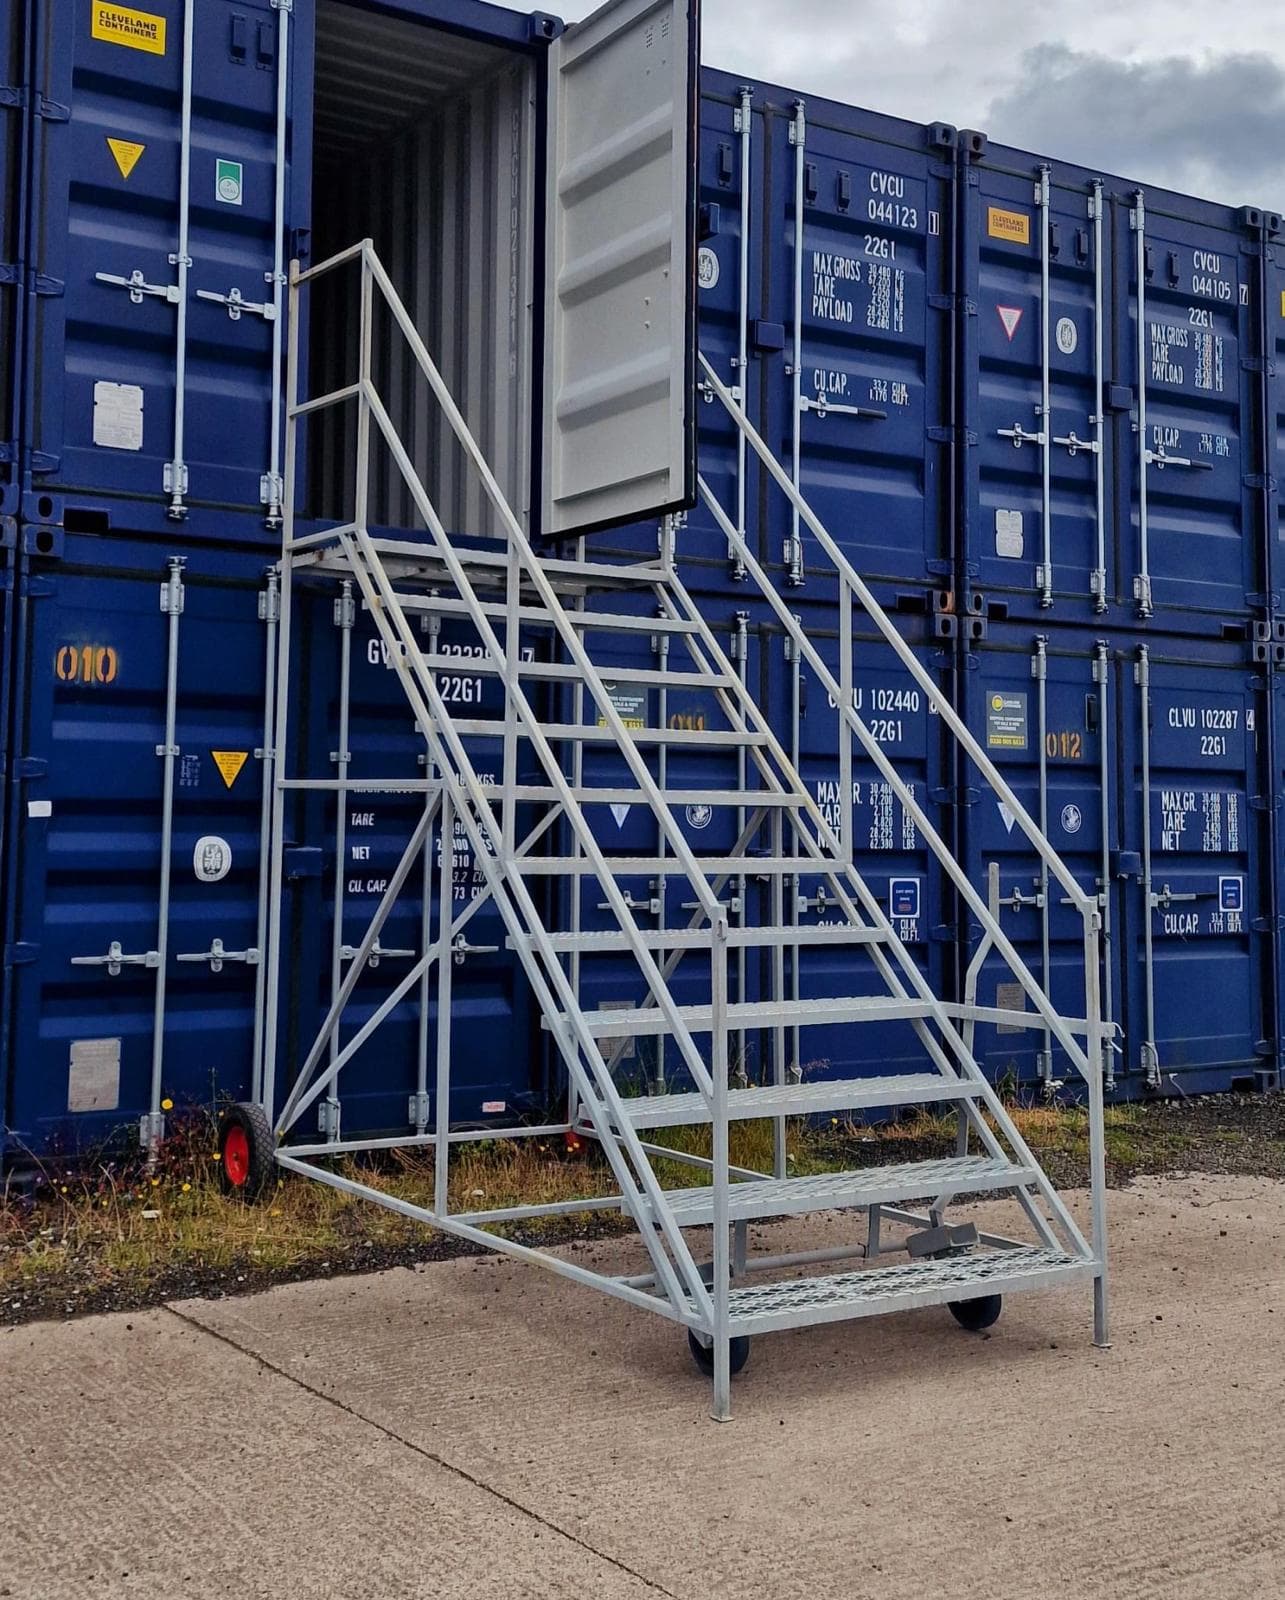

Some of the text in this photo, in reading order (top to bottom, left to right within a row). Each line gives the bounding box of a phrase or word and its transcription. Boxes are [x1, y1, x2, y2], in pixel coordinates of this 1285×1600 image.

[100, 11, 157, 32] CLEVELAND
[870, 172, 904, 198] CVCU
[868, 199, 917, 229] 044123
[864, 234, 896, 260] 22G1
[814, 252, 832, 276] MAX
[834, 256, 861, 282] GROSS
[1194, 250, 1220, 274] CVCU
[814, 274, 836, 298] TARE
[1192, 275, 1230, 300] 044105
[812, 296, 852, 322] PAYLOAD
[1188, 307, 1213, 328] 22G1
[1152, 324, 1188, 348] MAX GROSS
[1152, 342, 1169, 362] TARE
[1152, 362, 1184, 384] PAYLOAD
[57, 646, 116, 683] 010
[441, 677, 482, 702] 22G1
[872, 689, 919, 712] 102440
[1169, 708, 1196, 728] CLVU
[1201, 709, 1238, 729] 102287
[870, 720, 902, 742] 22G1
[1046, 732, 1080, 758] 012
[1201, 736, 1226, 755] 22G1
[1162, 791, 1197, 812] MAX.GR.
[352, 814, 374, 826] TARE
[1162, 810, 1186, 831] TARE
[1162, 830, 1180, 850] NET
[352, 846, 370, 860] NET
[1164, 914, 1199, 934] CU.CAP.
